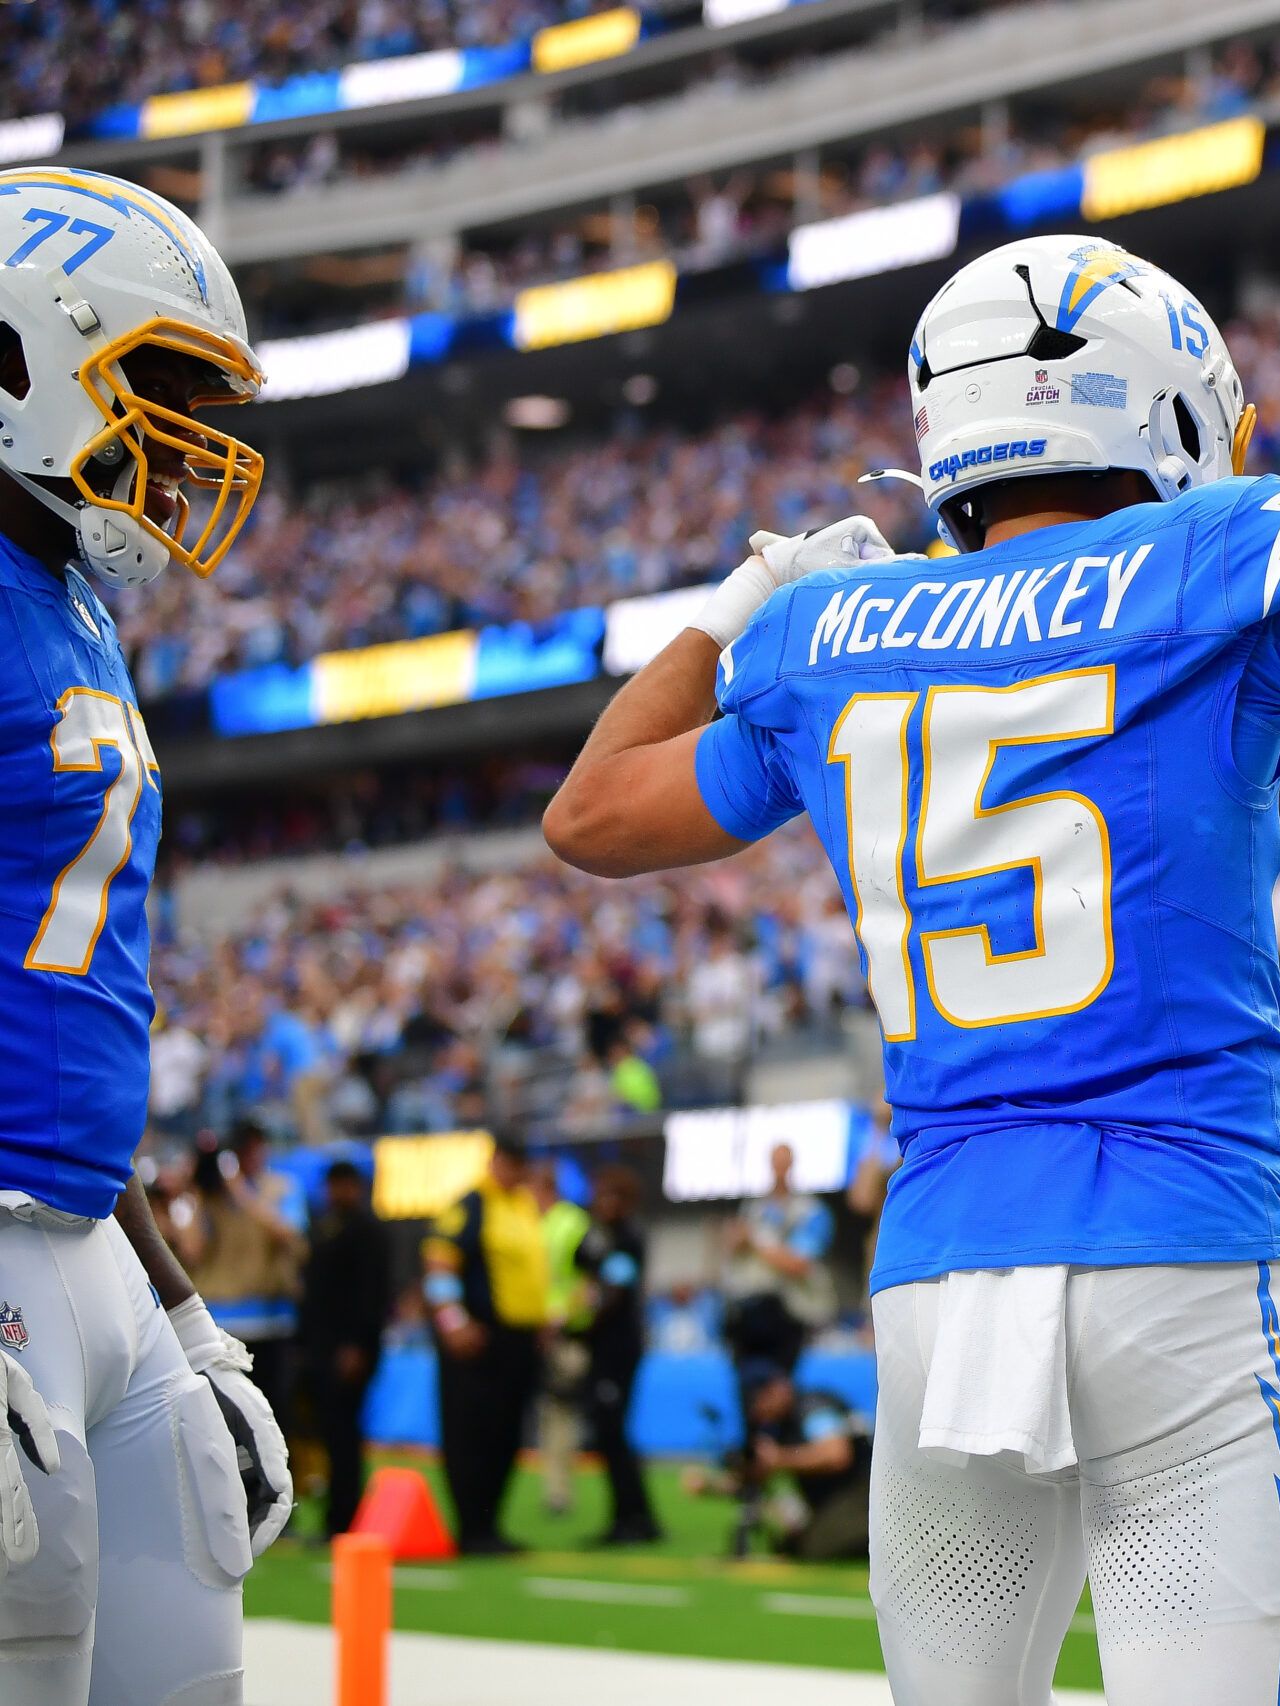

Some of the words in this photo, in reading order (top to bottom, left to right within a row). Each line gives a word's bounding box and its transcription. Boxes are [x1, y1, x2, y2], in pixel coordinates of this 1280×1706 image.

[4, 207, 116, 277] 77
[1158, 289, 1210, 360] 15
[1026, 389, 1060, 402] CATCH
[928, 437, 1048, 482] CHARGERS
[826, 664, 1116, 1042] 15
